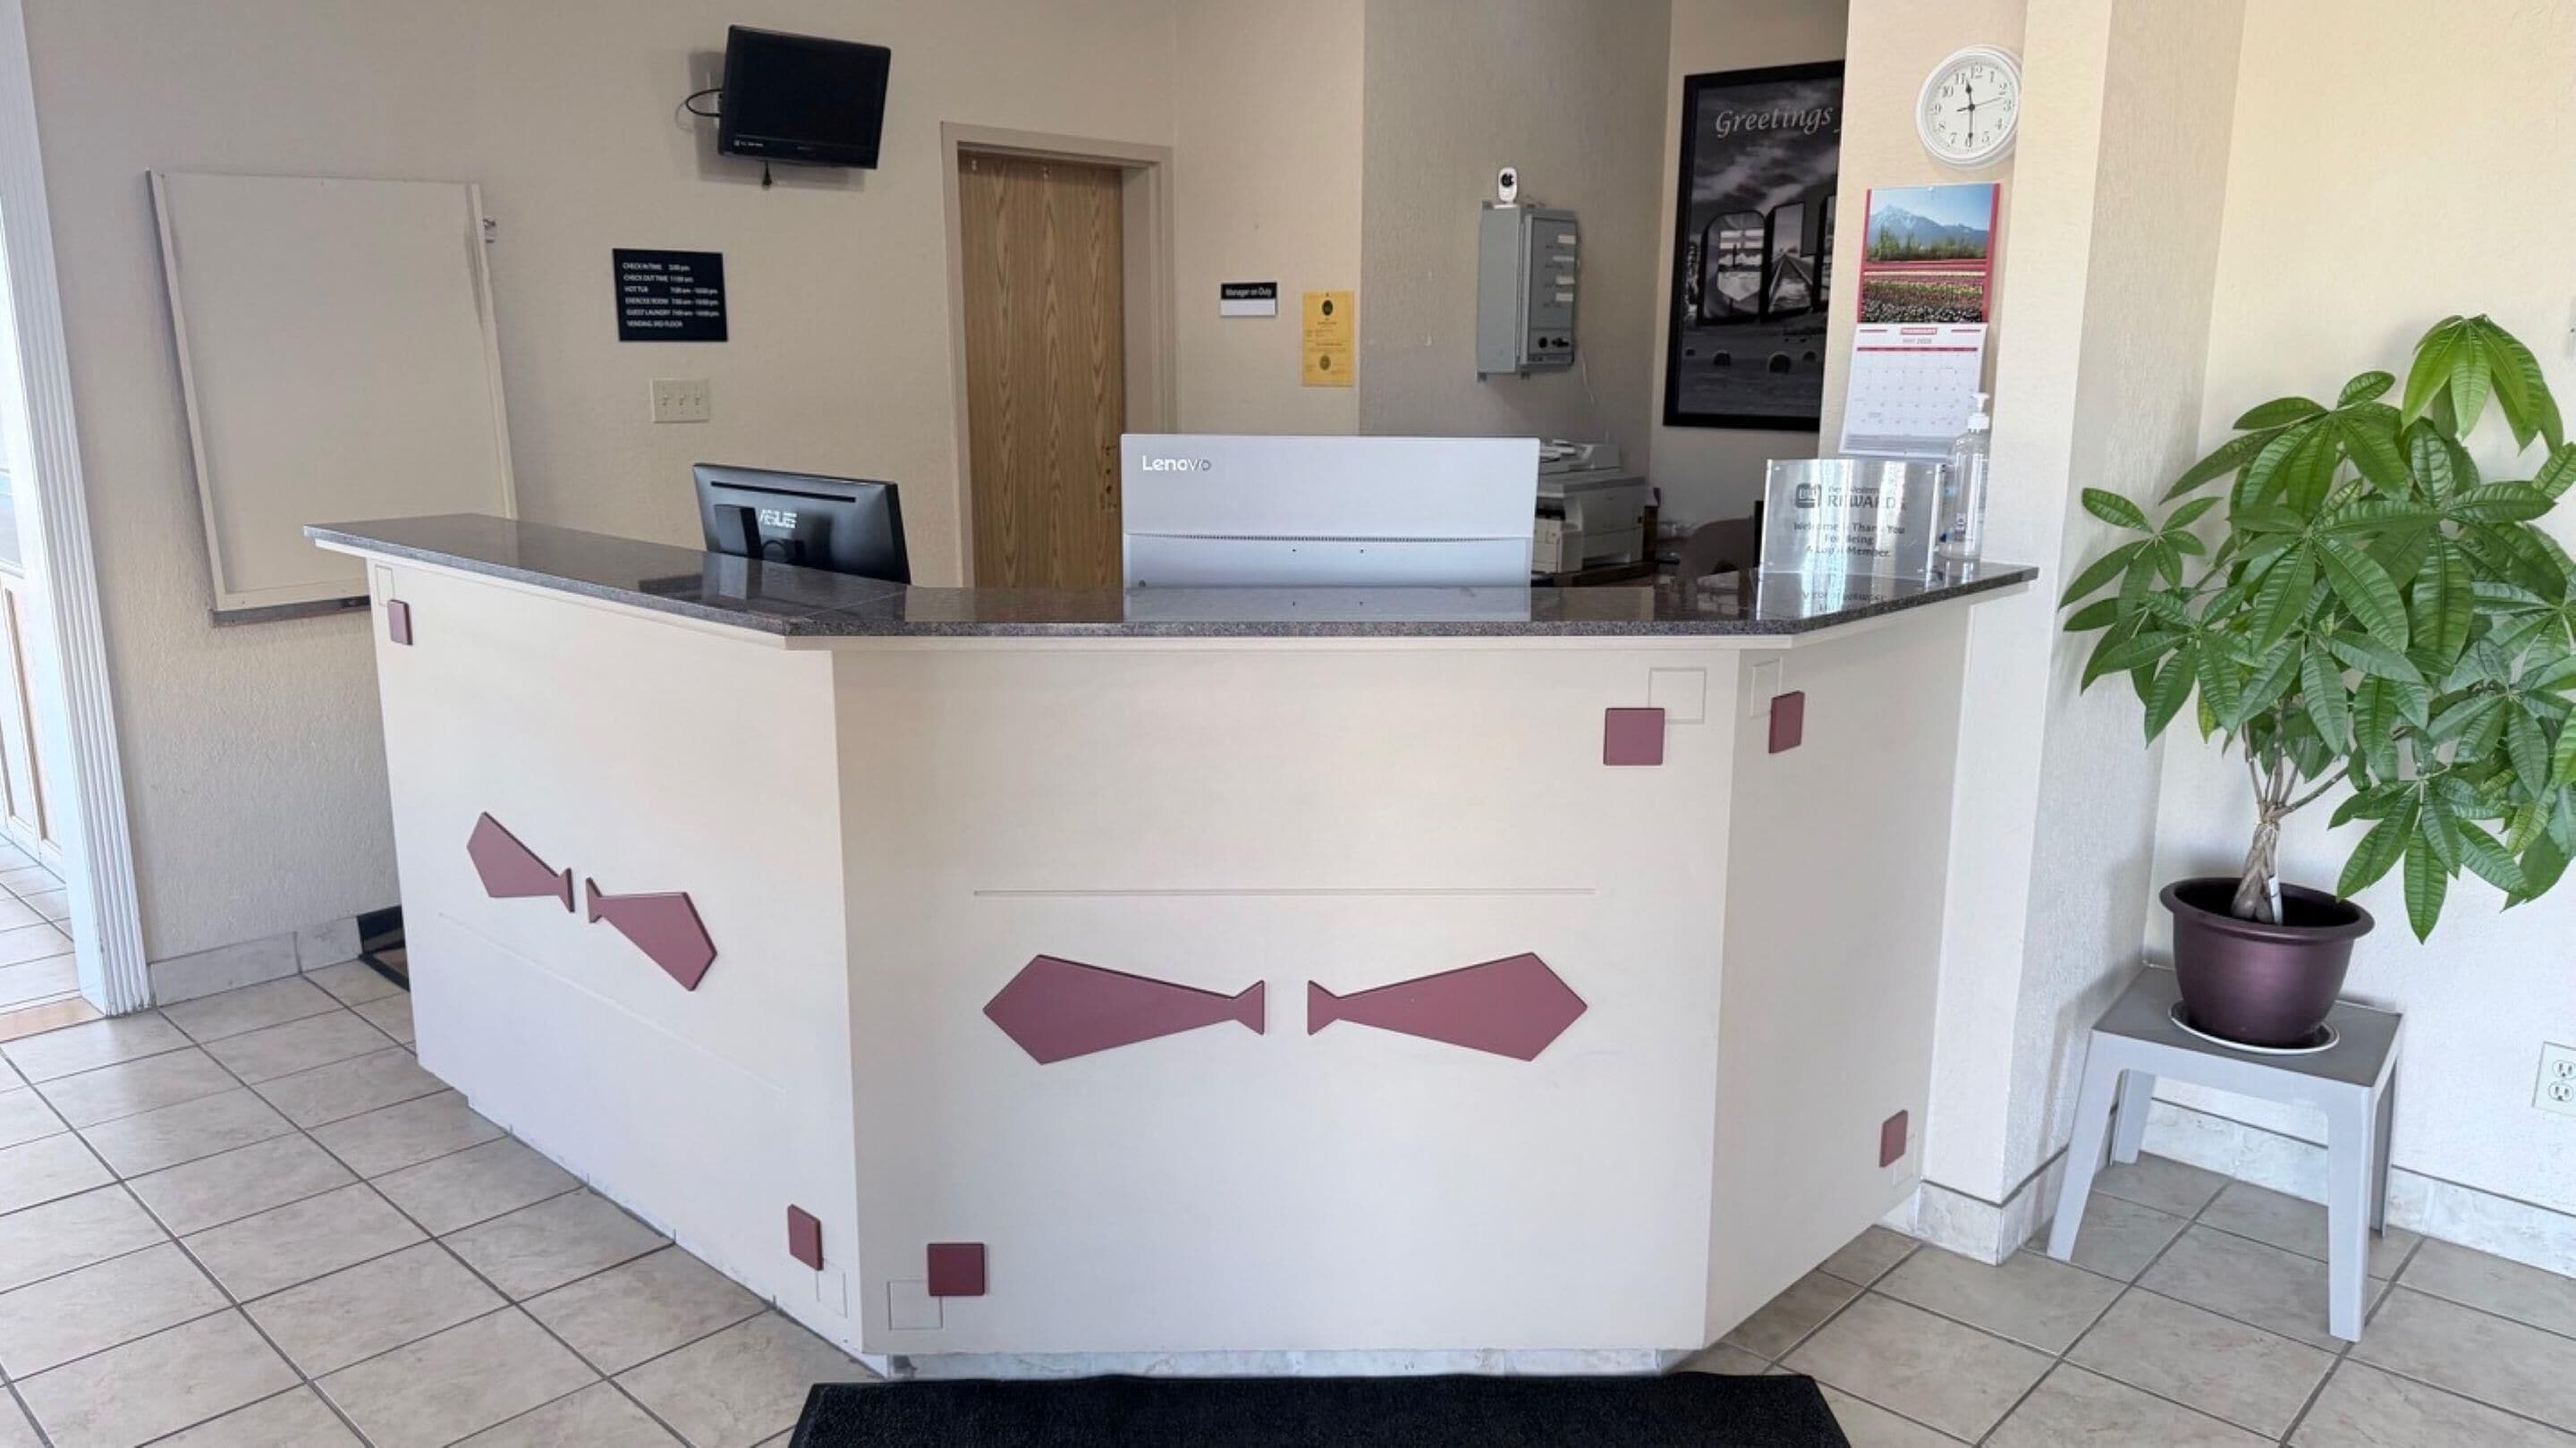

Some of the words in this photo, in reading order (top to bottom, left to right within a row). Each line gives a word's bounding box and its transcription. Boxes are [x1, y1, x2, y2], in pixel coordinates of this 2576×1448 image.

[1970, 62, 1983, 80] 12
[1989, 71, 1996, 83] 1
[1954, 72, 1966, 85] 11
[1941, 86, 1954, 97] 10
[1998, 82, 2008, 96] 2
[1934, 103, 1942, 115] 9
[2003, 99, 2012, 112] 3
[1715, 106, 1834, 139] Greetings
[1938, 121, 1947, 131] 8
[1951, 131, 1958, 144] 7
[1981, 131, 1990, 143] 5
[1141, 454, 1213, 471] Lenovo
[1793, 521, 1839, 531] Welome
[1852, 521, 1885, 532] Than
